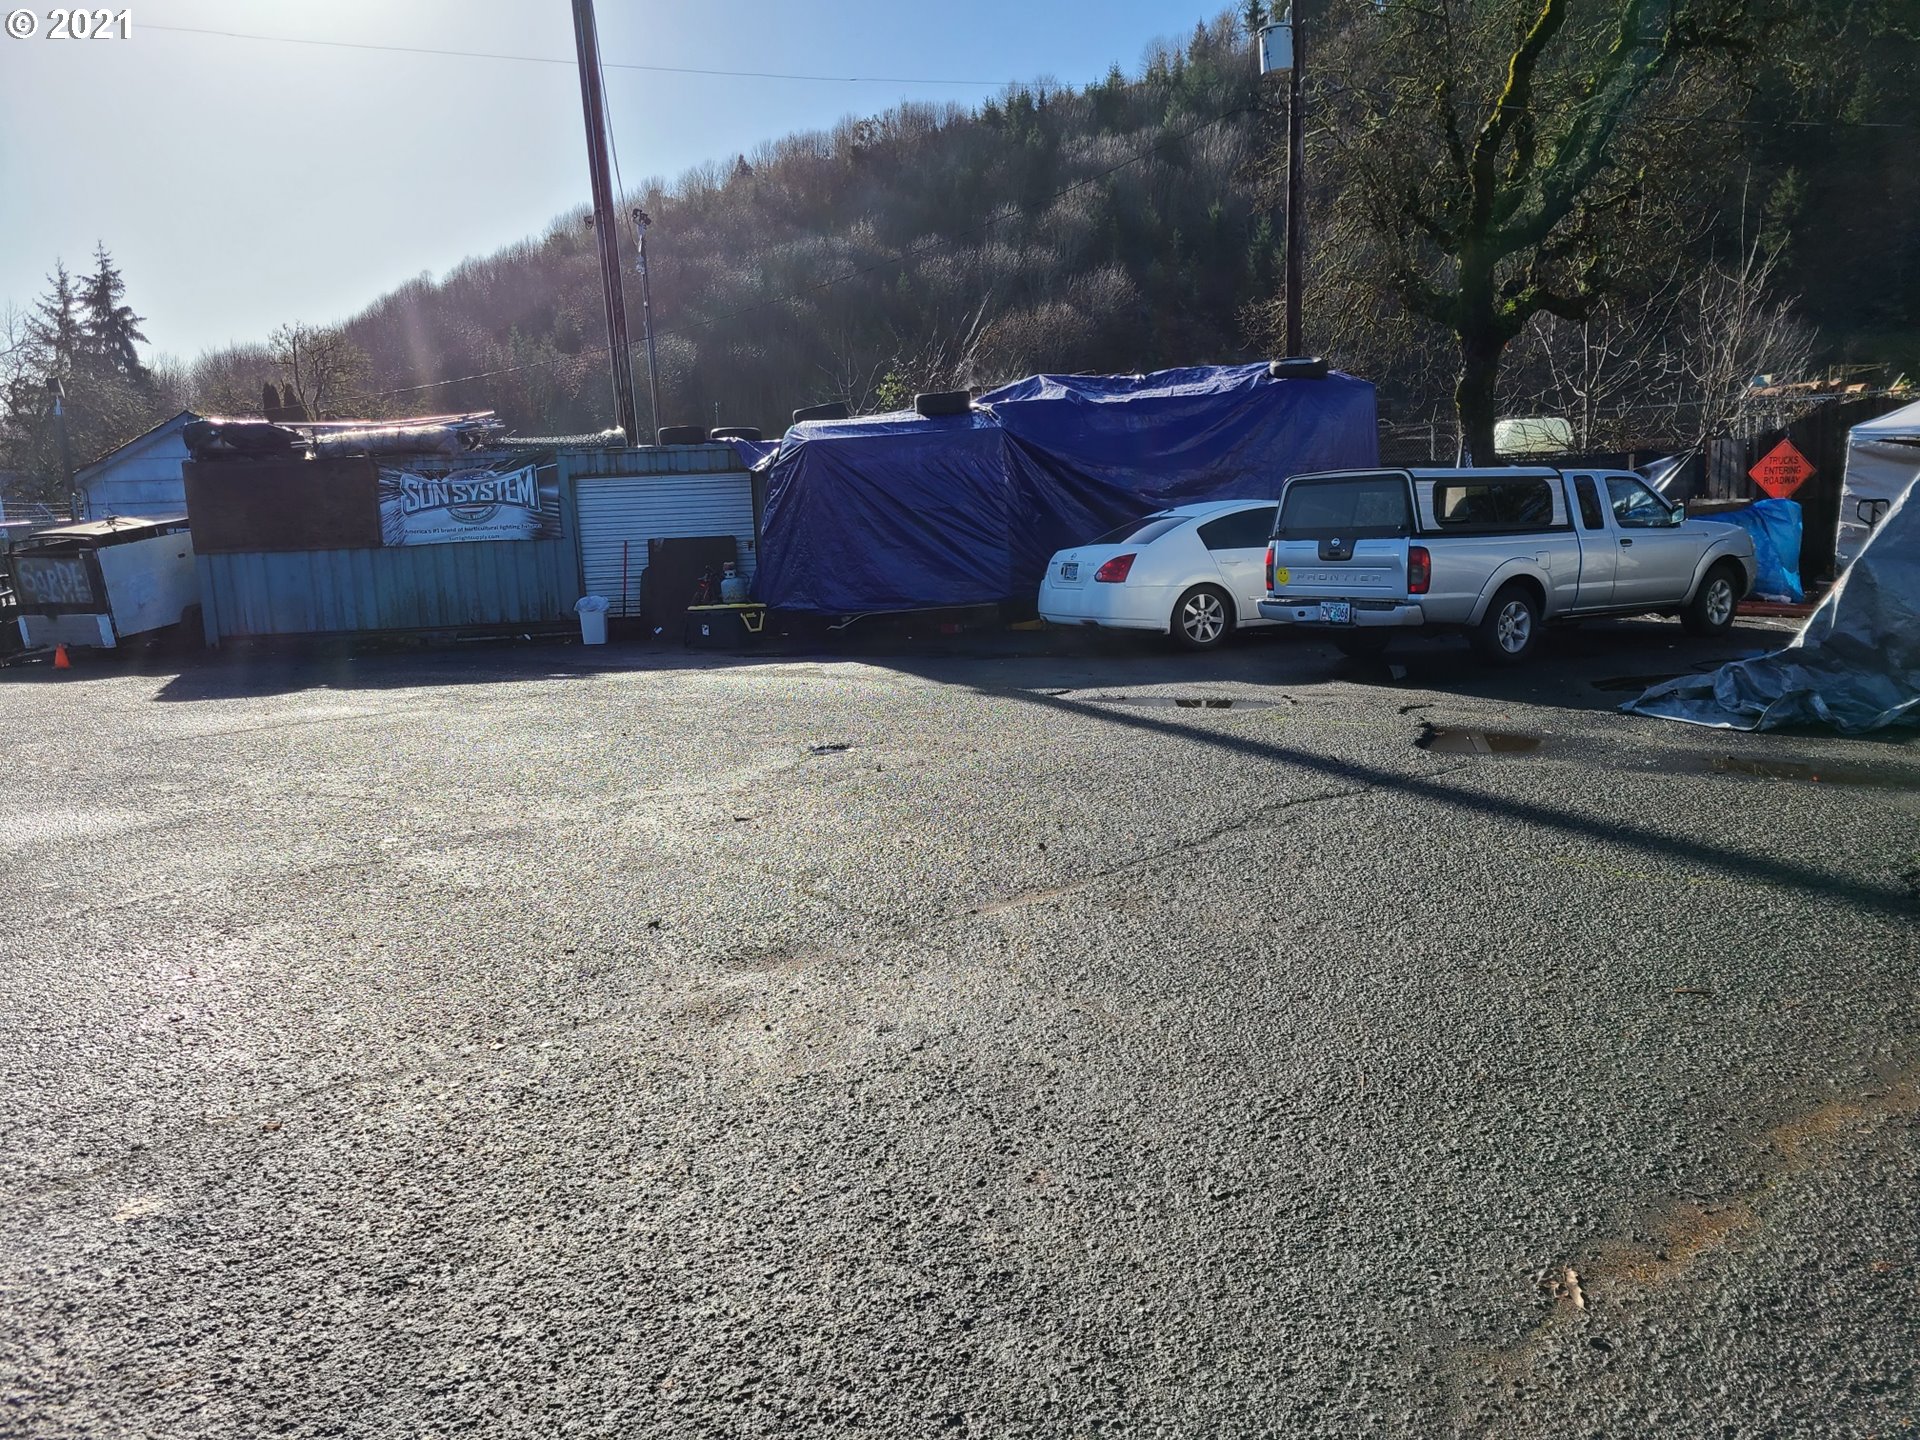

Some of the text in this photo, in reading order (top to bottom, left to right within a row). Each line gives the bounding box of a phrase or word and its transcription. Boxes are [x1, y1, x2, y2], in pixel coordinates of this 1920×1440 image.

[1769, 456, 1799, 465] TRUCKS
[1764, 466, 1802, 475] ENTERING
[1763, 476, 1801, 485] ROADWAY
[402, 477, 449, 514] SUN
[452, 466, 536, 507] SYSTEM
[1296, 574, 1382, 582] FRONTIER
